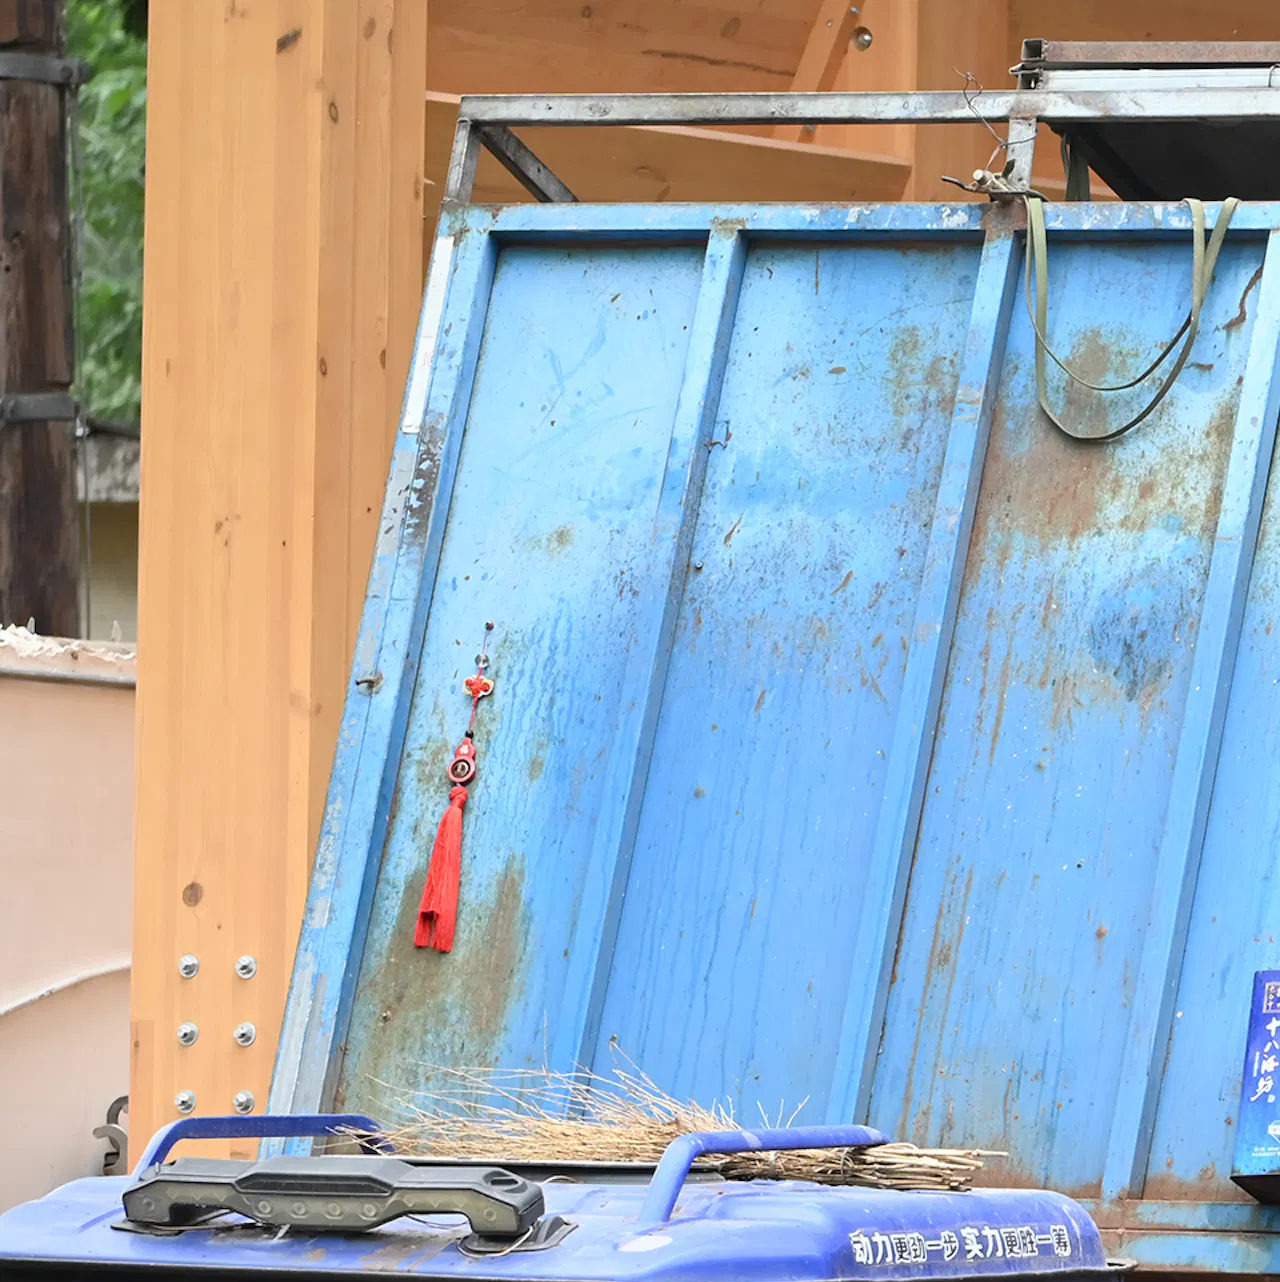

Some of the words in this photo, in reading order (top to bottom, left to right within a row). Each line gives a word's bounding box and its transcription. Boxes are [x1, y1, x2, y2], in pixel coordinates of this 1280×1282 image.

[848, 1228, 959, 1265] 动力更劲一步
[960, 1225, 1071, 1259] 实力更胜一筹
